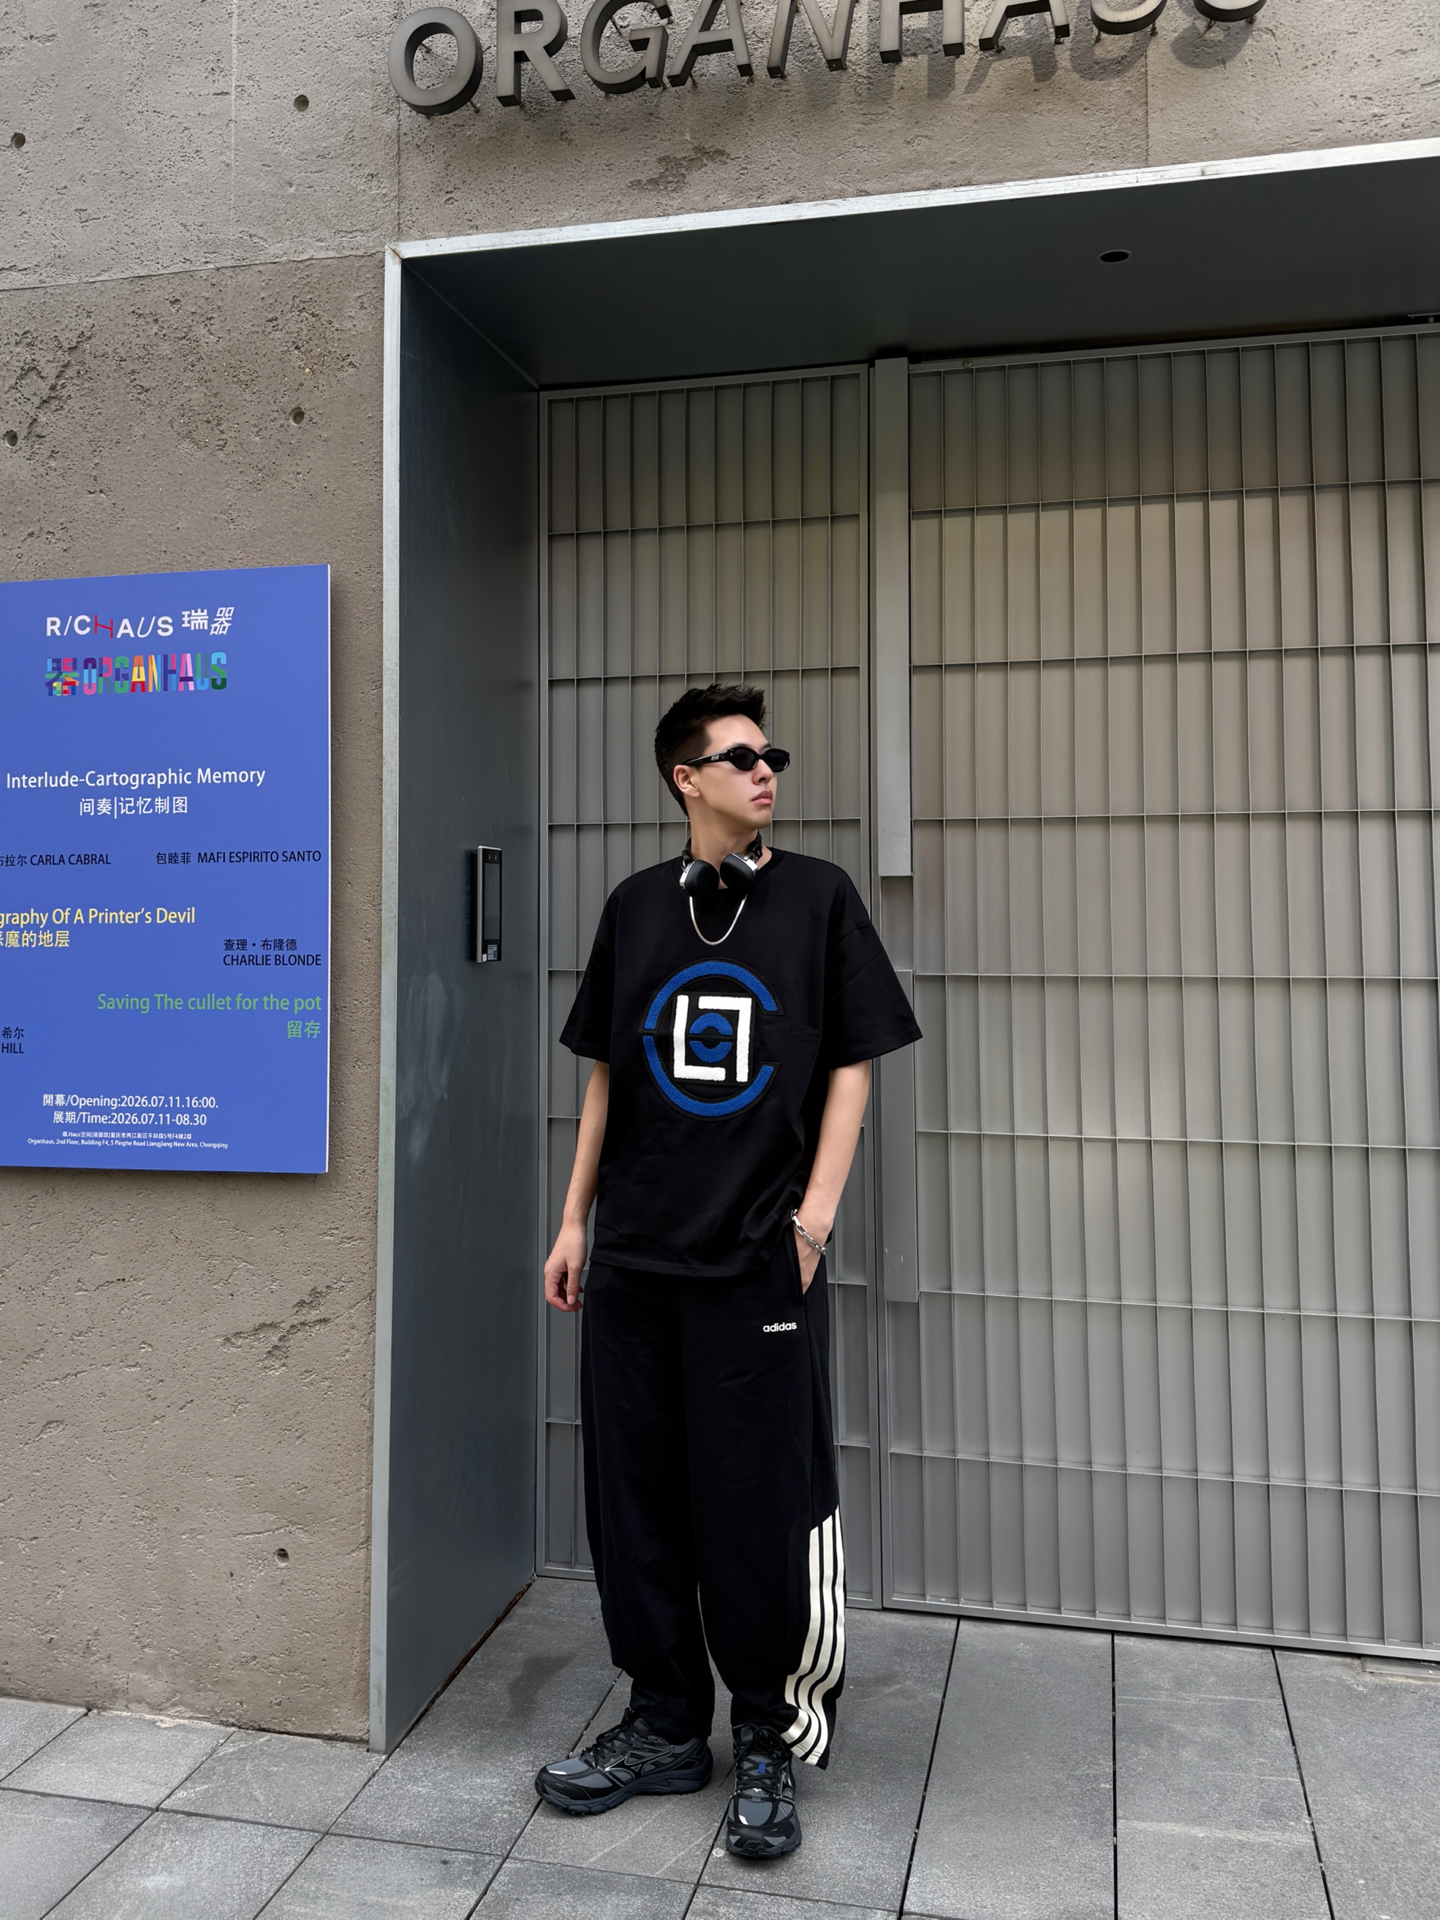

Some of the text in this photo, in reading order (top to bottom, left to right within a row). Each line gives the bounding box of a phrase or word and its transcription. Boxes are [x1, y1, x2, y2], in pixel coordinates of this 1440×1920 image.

[387, 0, 1269, 116] ORGAN
[181, 607, 235, 635] 瑞器
[6, 768, 266, 791] Interlude-Cartographic Memory
[30, 854, 65, 866] CARLA
[68, 853, 112, 865] CABRAL
[156, 850, 322, 865] 包睦菲 MAFI ESPIRITO SANTO
[52, 907, 71, 924] Of
[73, 908, 85, 924] A
[156, 907, 196, 924] Devil
[0, 930, 70, 948] 魔的地层
[223, 954, 322, 966] CHARLIE BLONDE
[97, 993, 322, 1015] Saving The cullet for the pot
[2, 1026, 25, 1040] 希尔
[286, 1020, 322, 1039] 留存
[2, 1042, 25, 1054] HILL
[762, 1321, 798, 1333] adidas
